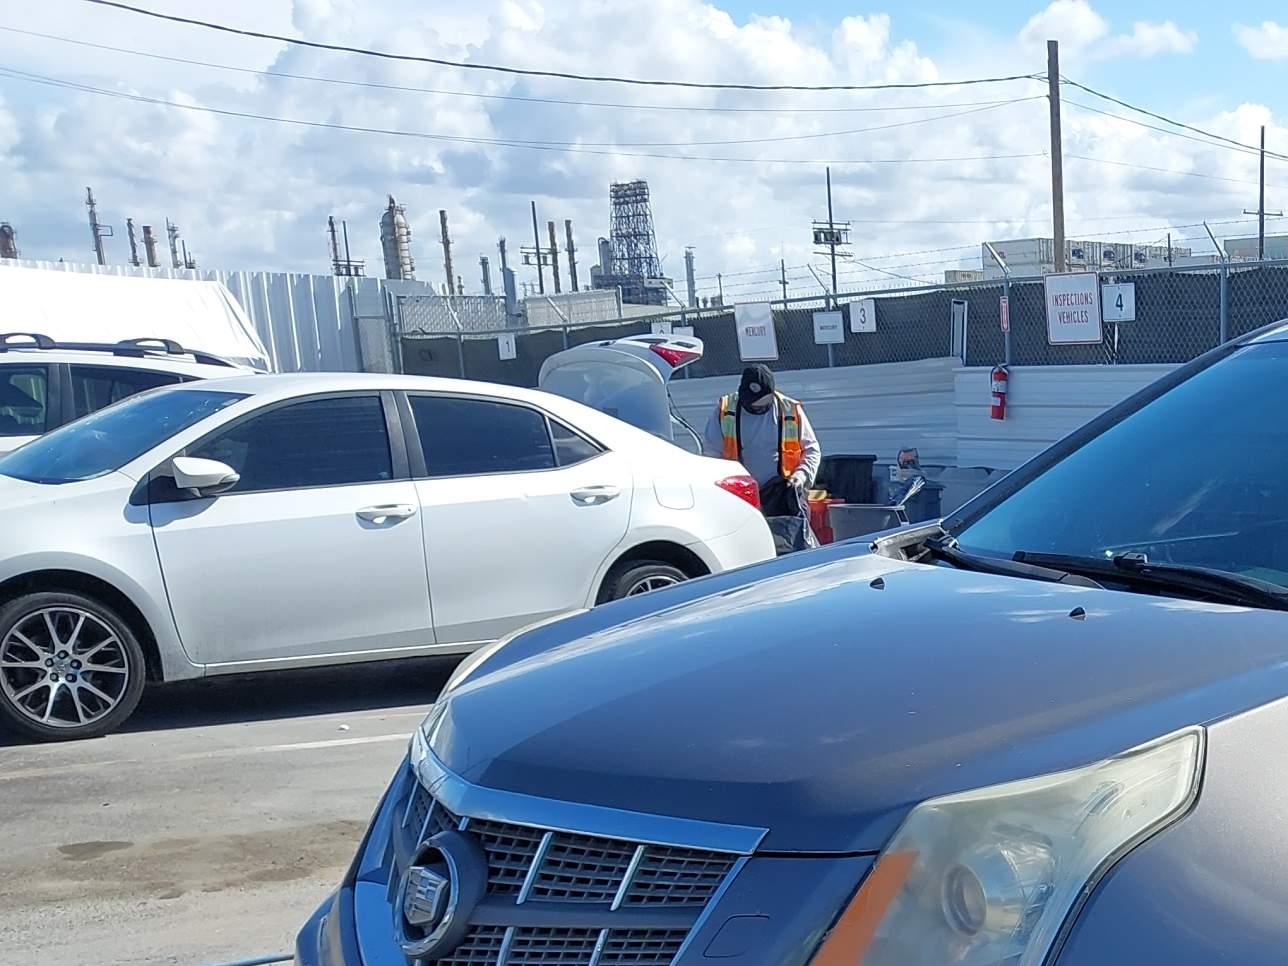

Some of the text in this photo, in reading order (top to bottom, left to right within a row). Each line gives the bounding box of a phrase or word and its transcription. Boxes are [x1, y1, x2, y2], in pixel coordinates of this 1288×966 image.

[1052, 292, 1093, 307] INSPECTIONS
[1115, 293, 1124, 312] 4
[860, 307, 867, 324] 3
[1057, 310, 1089, 324] VEHICLES
